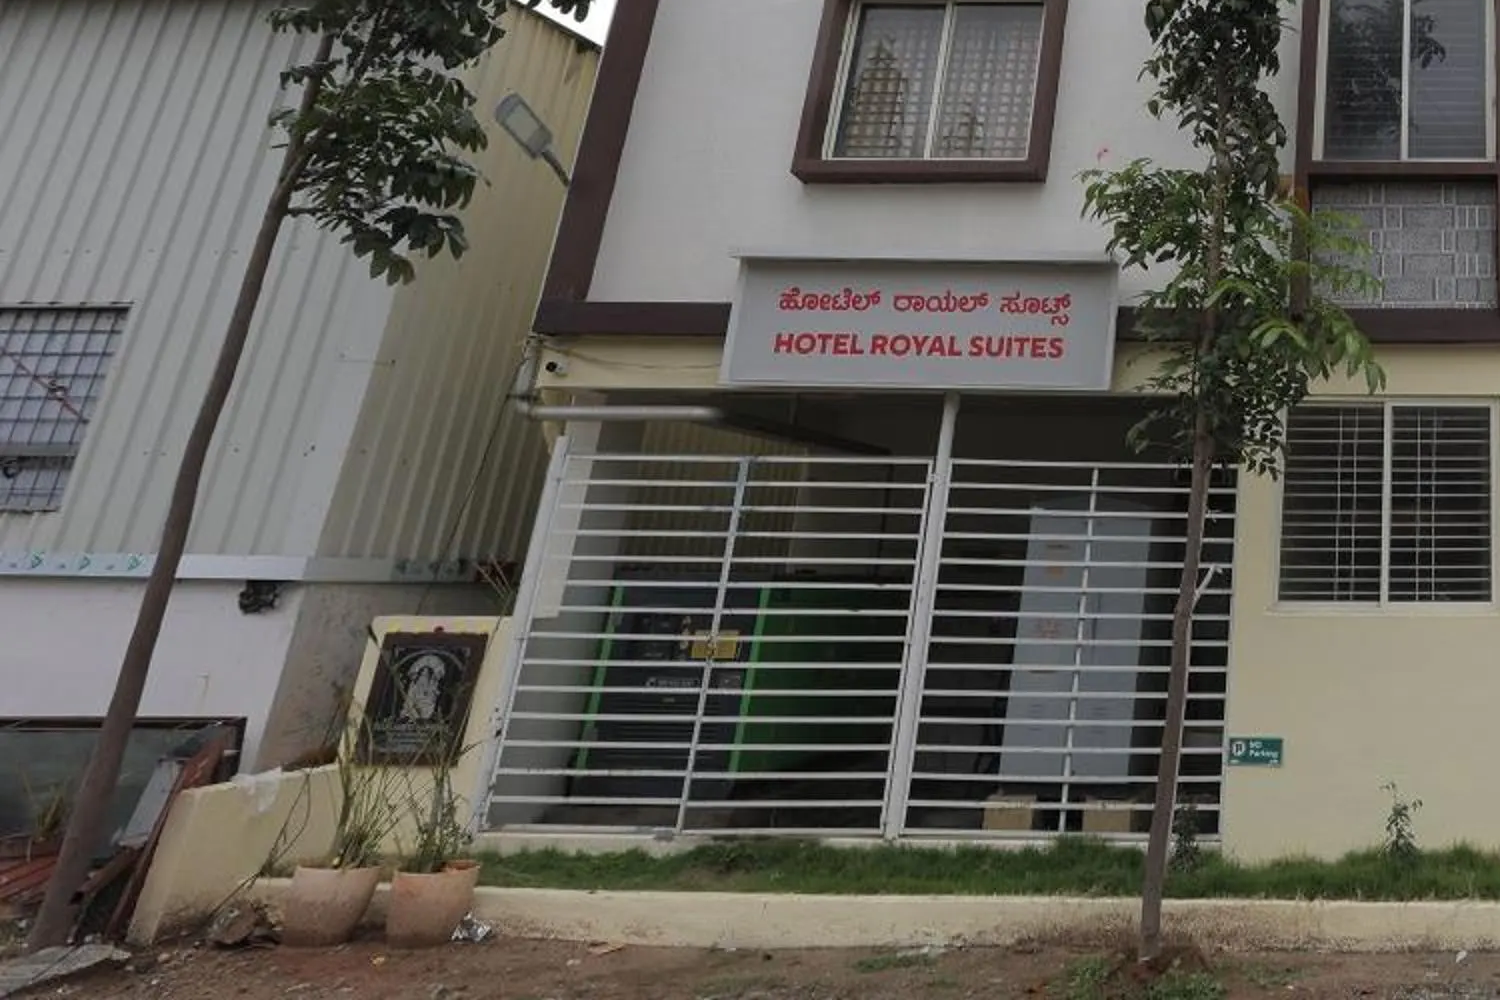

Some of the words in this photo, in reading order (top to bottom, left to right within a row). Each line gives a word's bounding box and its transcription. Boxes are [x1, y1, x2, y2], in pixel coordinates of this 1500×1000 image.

[779, 287, 881, 311] ಹೋಟೆಲ್
[893, 289, 989, 312] ರಾಯಲ್
[773, 332, 864, 355] HOTEL
[869, 334, 962, 356] ROYAL
[968, 335, 1064, 359] SUITES
